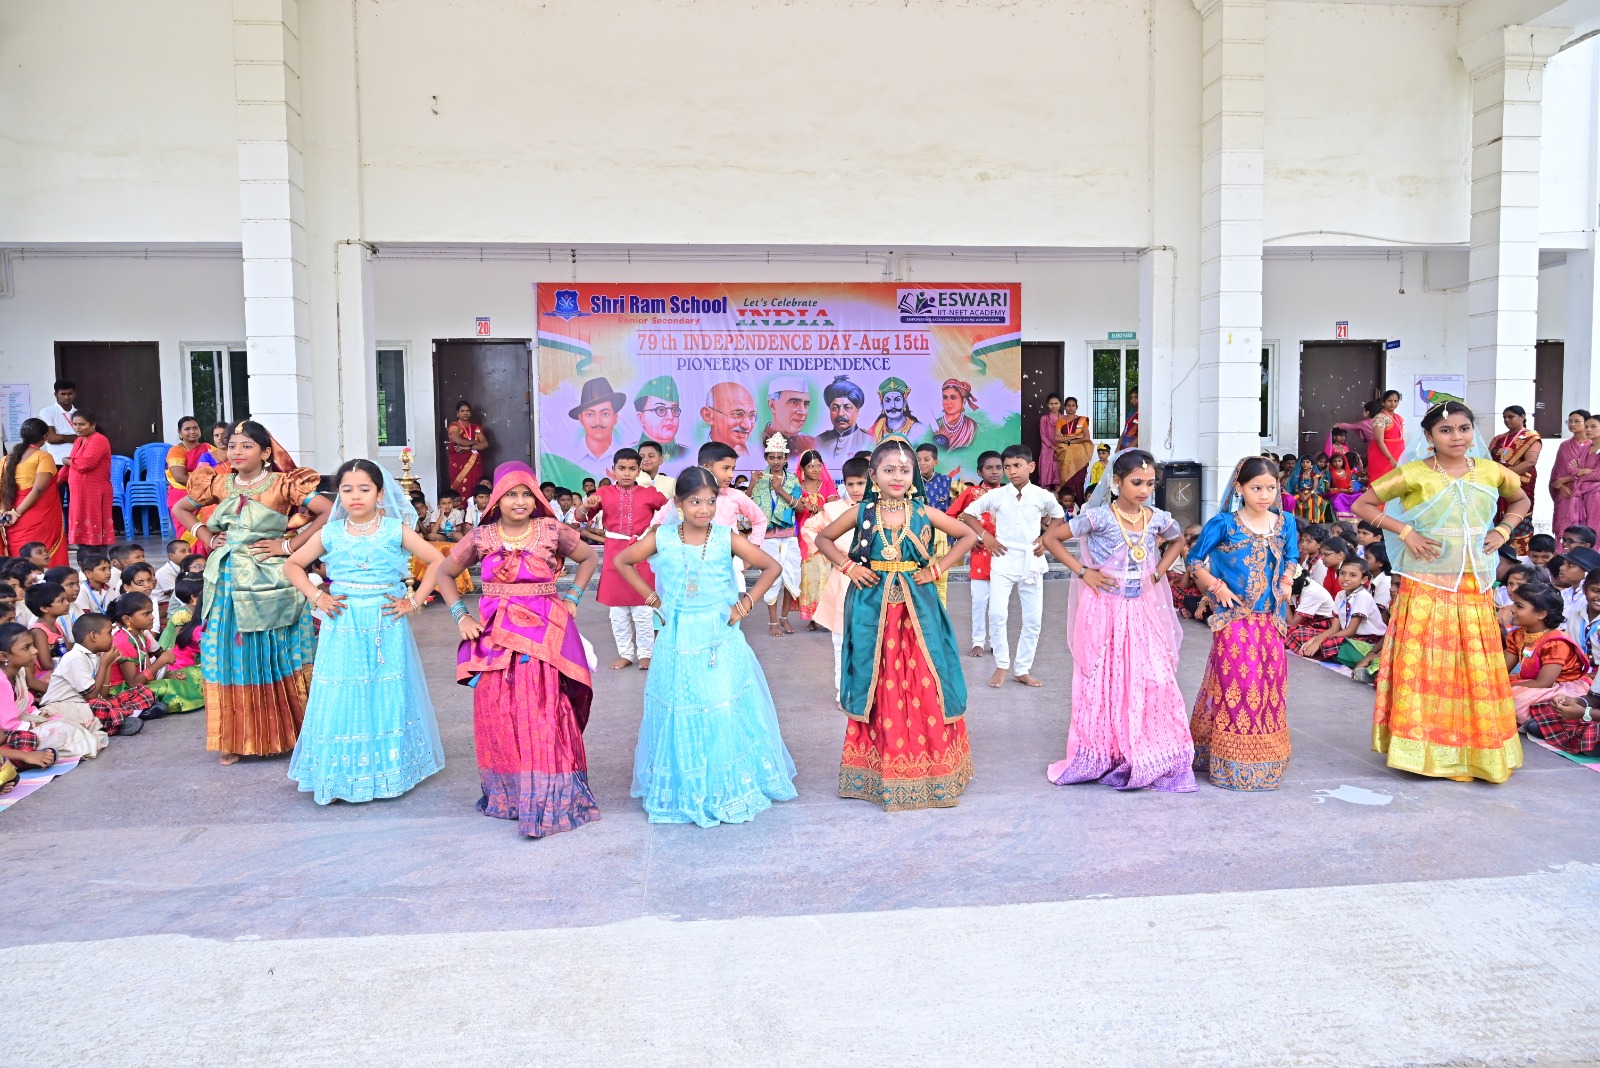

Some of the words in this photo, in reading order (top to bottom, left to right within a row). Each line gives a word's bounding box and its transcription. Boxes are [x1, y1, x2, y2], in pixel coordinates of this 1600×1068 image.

[590, 295, 625, 314] Shri
[629, 295, 666, 314] Ram
[670, 296, 728, 314] School
[743, 298, 767, 307] Let's
[771, 298, 818, 307] Celebrate
[938, 292, 1008, 307] ESWARI
[618, 317, 648, 325] Senior
[651, 317, 700, 325] Secondary
[736, 309, 834, 326] INDIA
[477, 321, 489, 335] 20
[1337, 325, 1347, 338] 21
[637, 333, 678, 351] 79th
[683, 333, 813, 351] INDEPENDENCE
[817, 333, 890, 354] DAY-Aug
[894, 333, 930, 351] 15th
[676, 357, 750, 372] PIONEERS
[754, 357, 774, 371] OF
[778, 357, 891, 371] INDEPENDENCE
